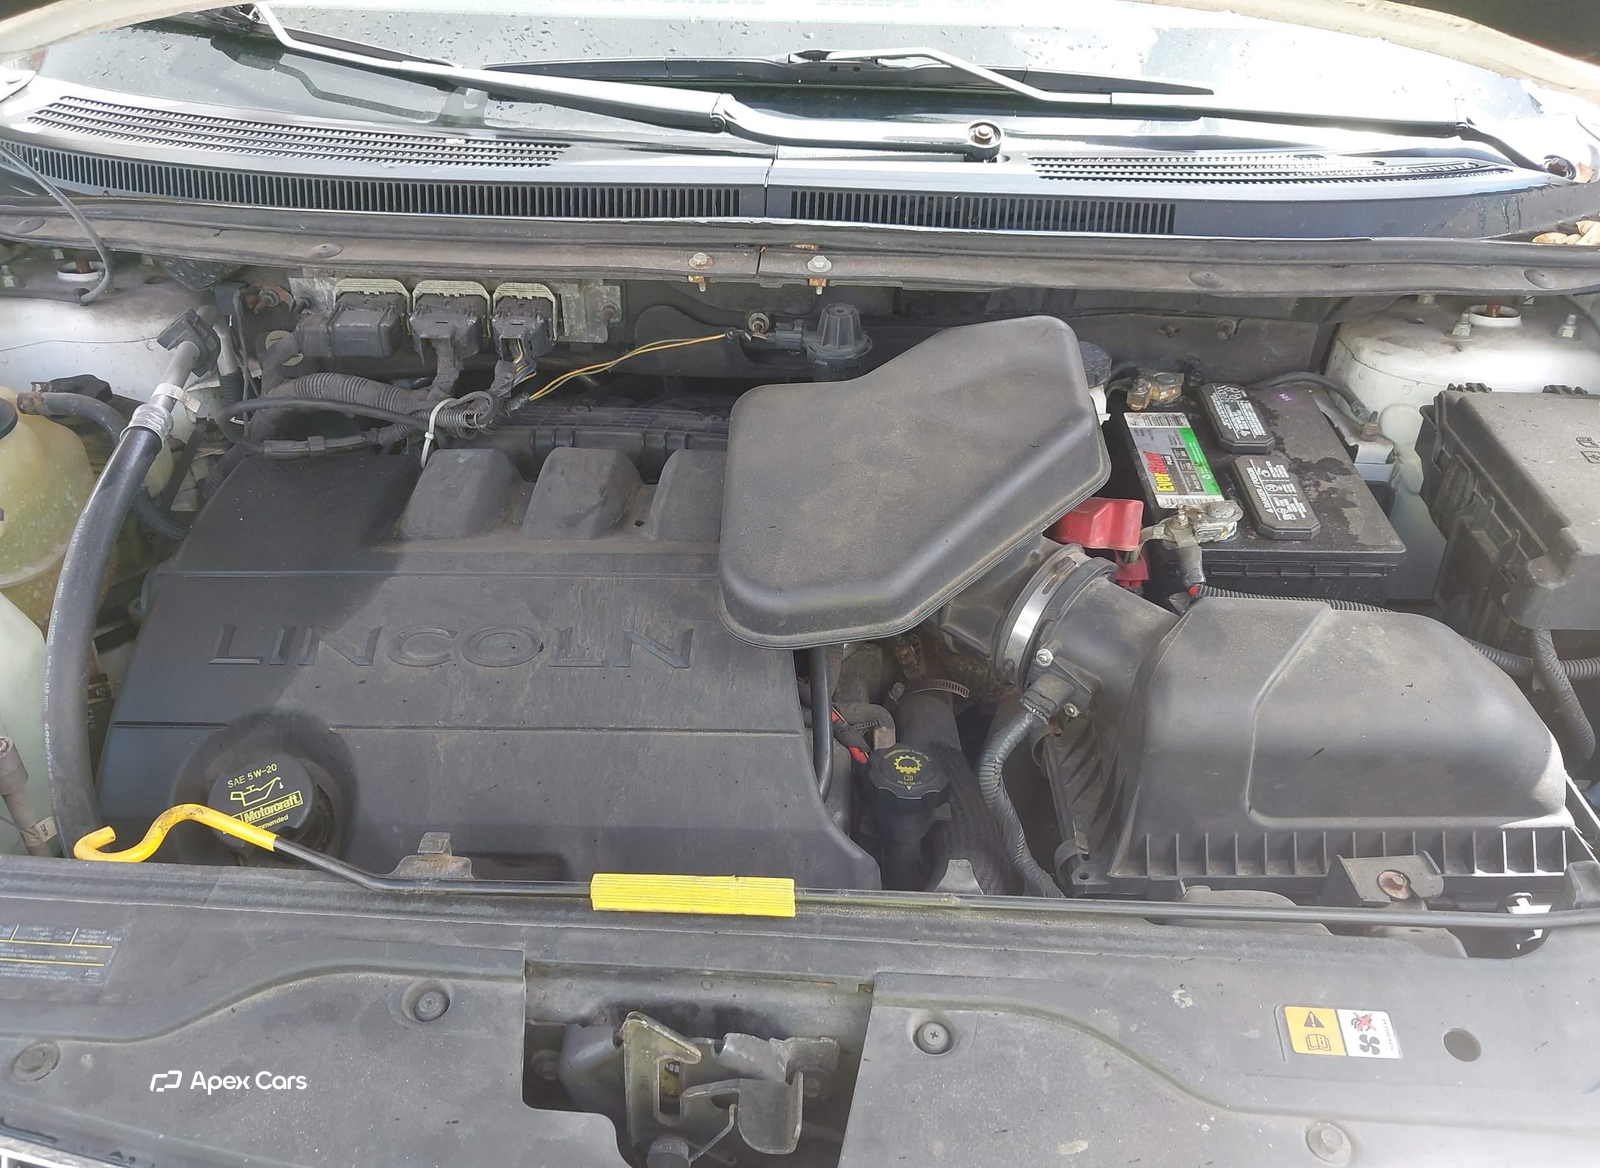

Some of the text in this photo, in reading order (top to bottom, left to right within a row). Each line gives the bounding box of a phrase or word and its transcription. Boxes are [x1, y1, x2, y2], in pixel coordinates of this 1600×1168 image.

[208, 625, 694, 669] LINCOLN
[227, 763, 278, 789] SAE 5W-20
[243, 794, 300, 824] Motorcraft
